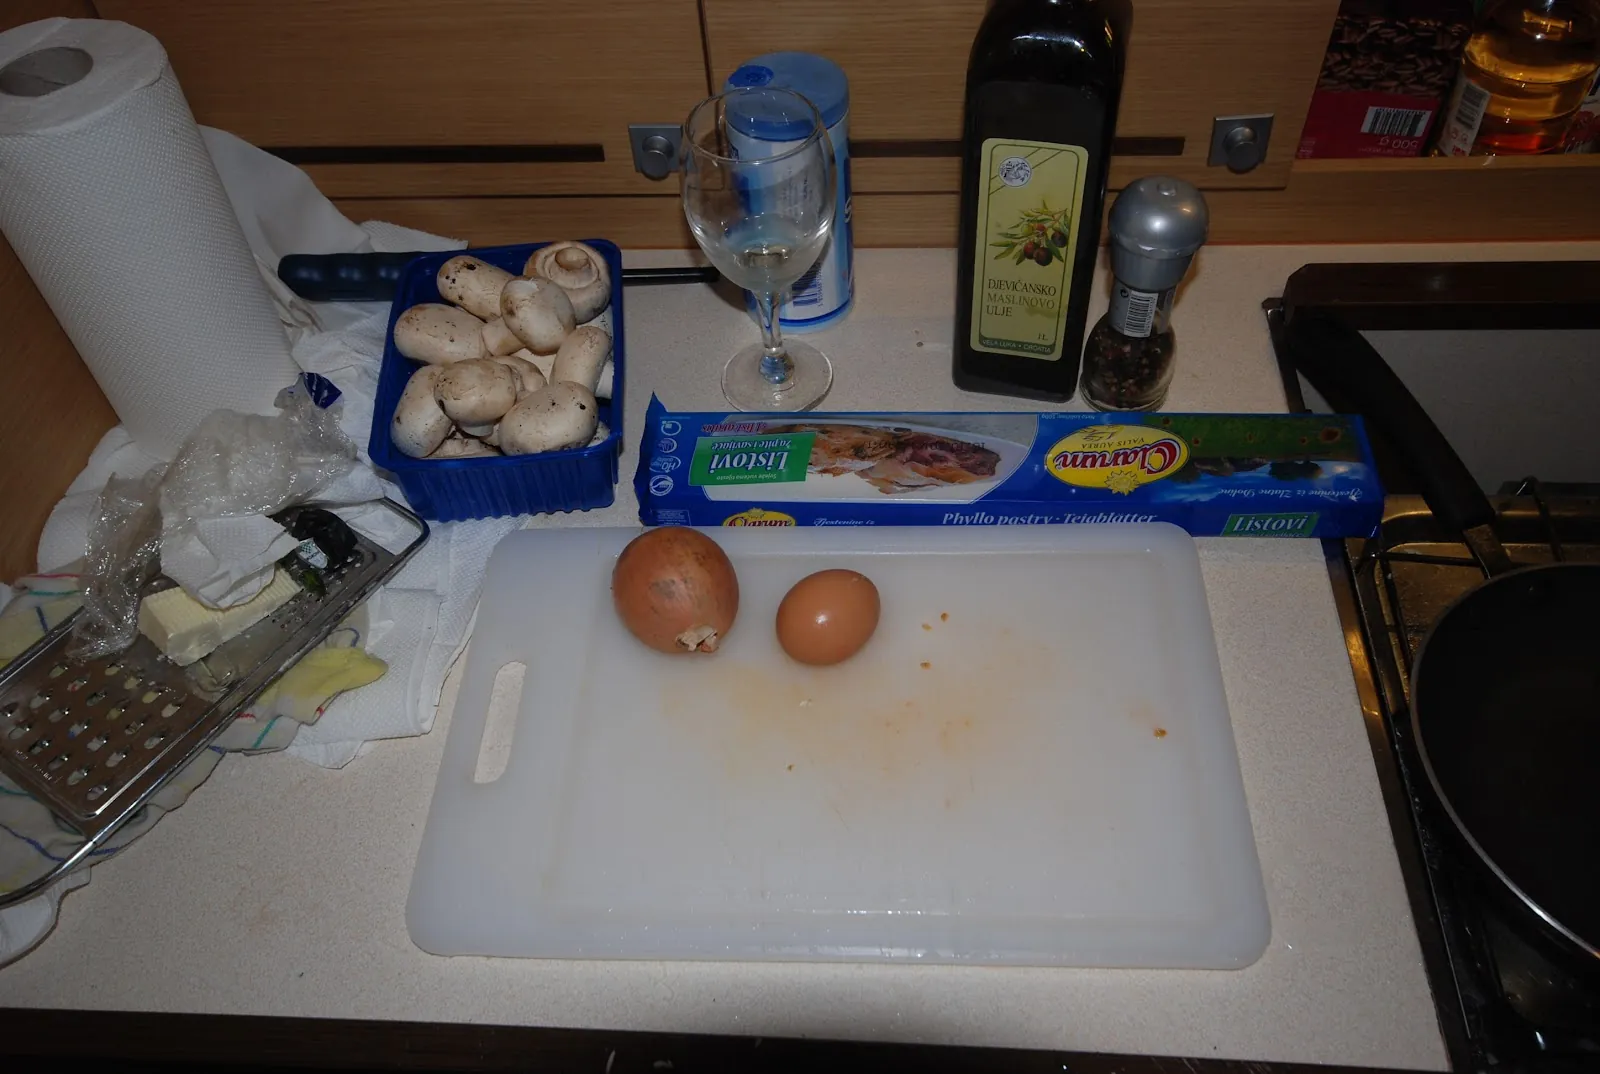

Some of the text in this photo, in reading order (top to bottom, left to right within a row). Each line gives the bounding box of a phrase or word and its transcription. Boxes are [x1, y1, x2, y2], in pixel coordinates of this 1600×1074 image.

[988, 279, 1057, 297] DJEVIČANSKO
[987, 293, 1055, 310] MASLINOVO
[986, 305, 1013, 317] ULJE
[1023, 344, 1051, 353] CROATIA
[1081, 438, 1145, 449] VALIS AUREA
[709, 451, 788, 474] Listovi
[1052, 438, 1182, 475] Clarum
[1218, 488, 1256, 498] Doline
[942, 512, 995, 526] Phyllo
[997, 512, 1053, 525] pastry
[1232, 515, 1309, 532] Listovi
